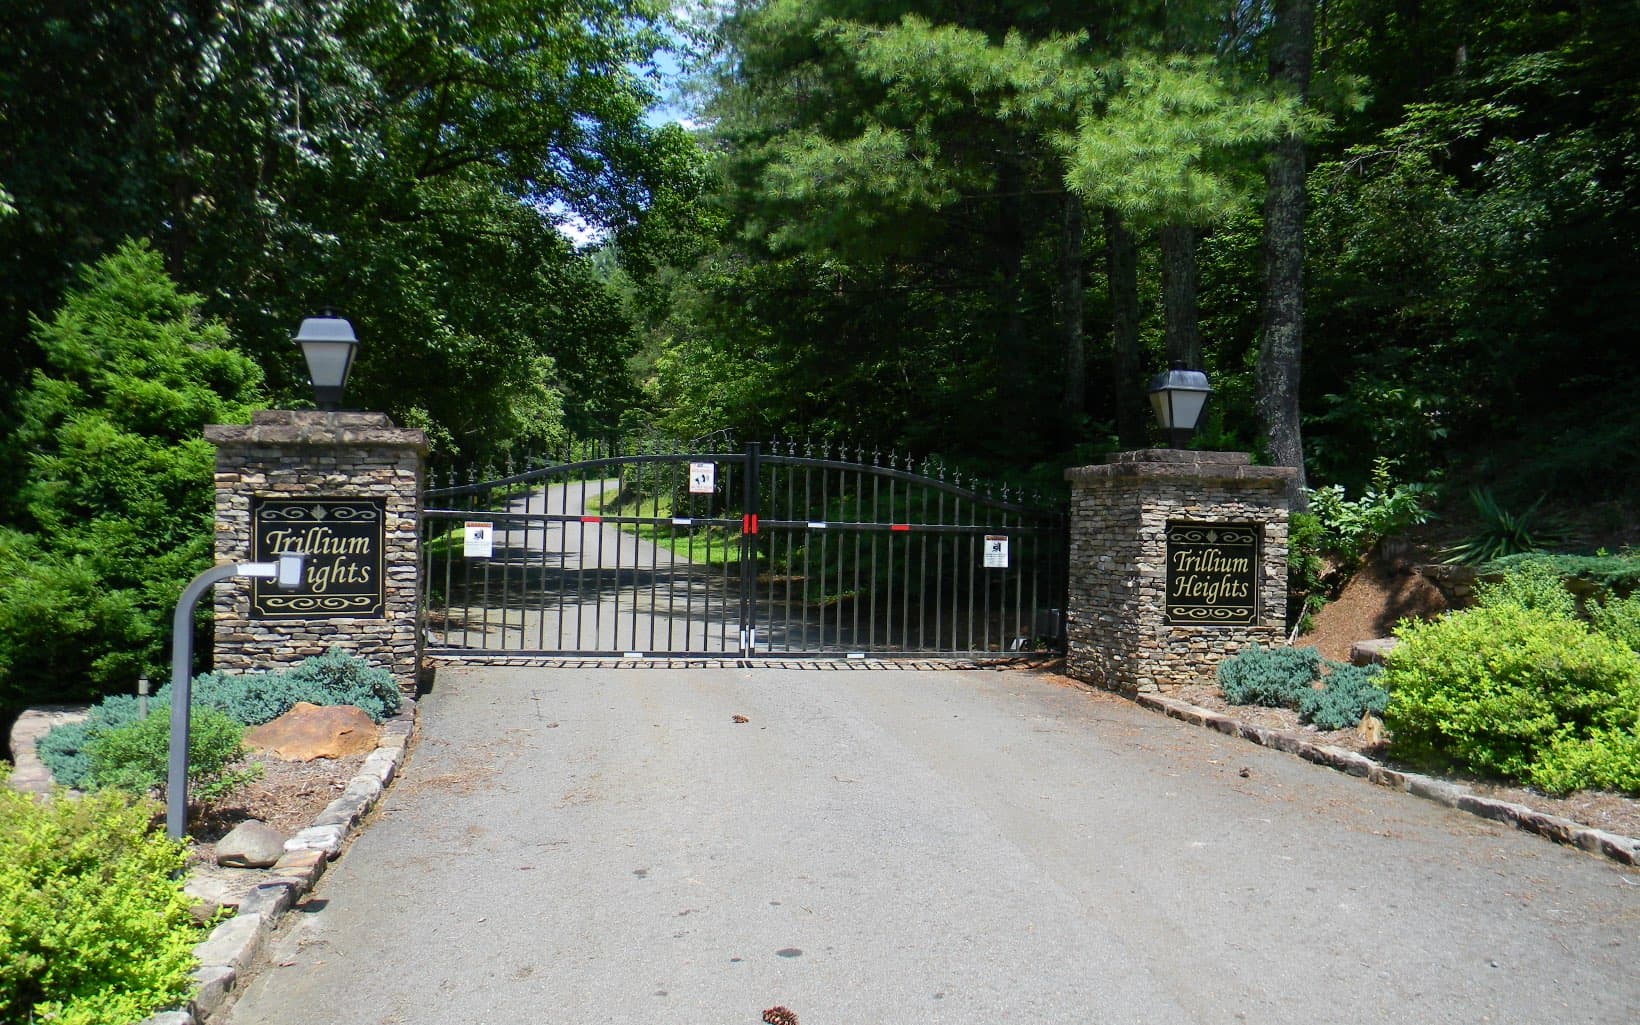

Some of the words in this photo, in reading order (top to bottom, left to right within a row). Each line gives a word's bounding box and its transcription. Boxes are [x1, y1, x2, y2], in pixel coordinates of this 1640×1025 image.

[266, 527, 371, 554] Trillium
[266, 556, 372, 593] ights
[1173, 548, 1249, 573] Trillium
[1172, 574, 1249, 605] Heights
